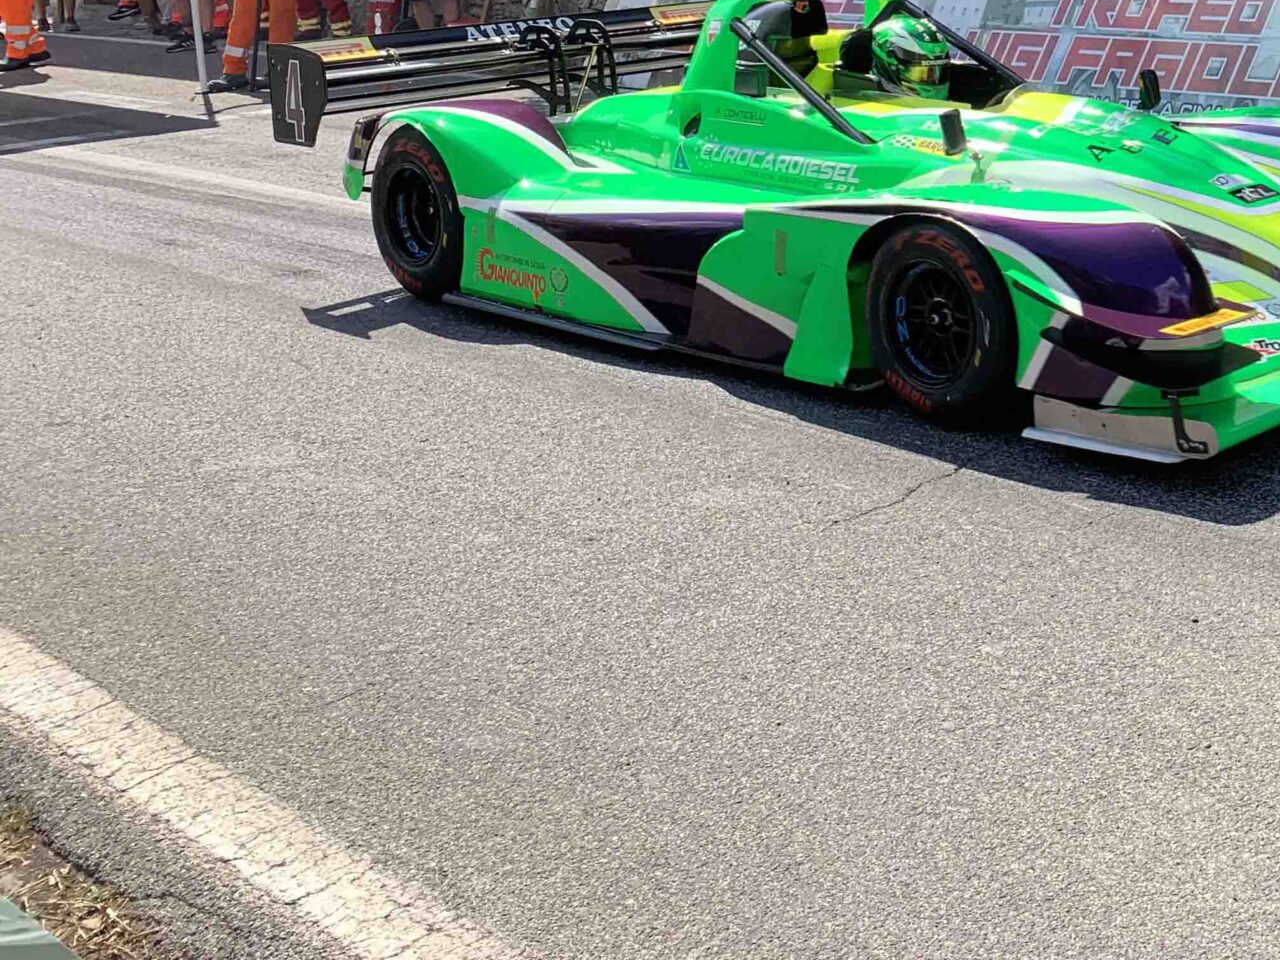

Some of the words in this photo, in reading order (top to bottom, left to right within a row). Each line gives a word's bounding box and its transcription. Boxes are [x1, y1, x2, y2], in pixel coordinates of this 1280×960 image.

[957, 29, 1061, 82] IGI
[700, 143, 860, 184] EUROCARDIESEL
[478, 248, 546, 293] GIANQUINTO
[916, 230, 985, 292] ZERO
